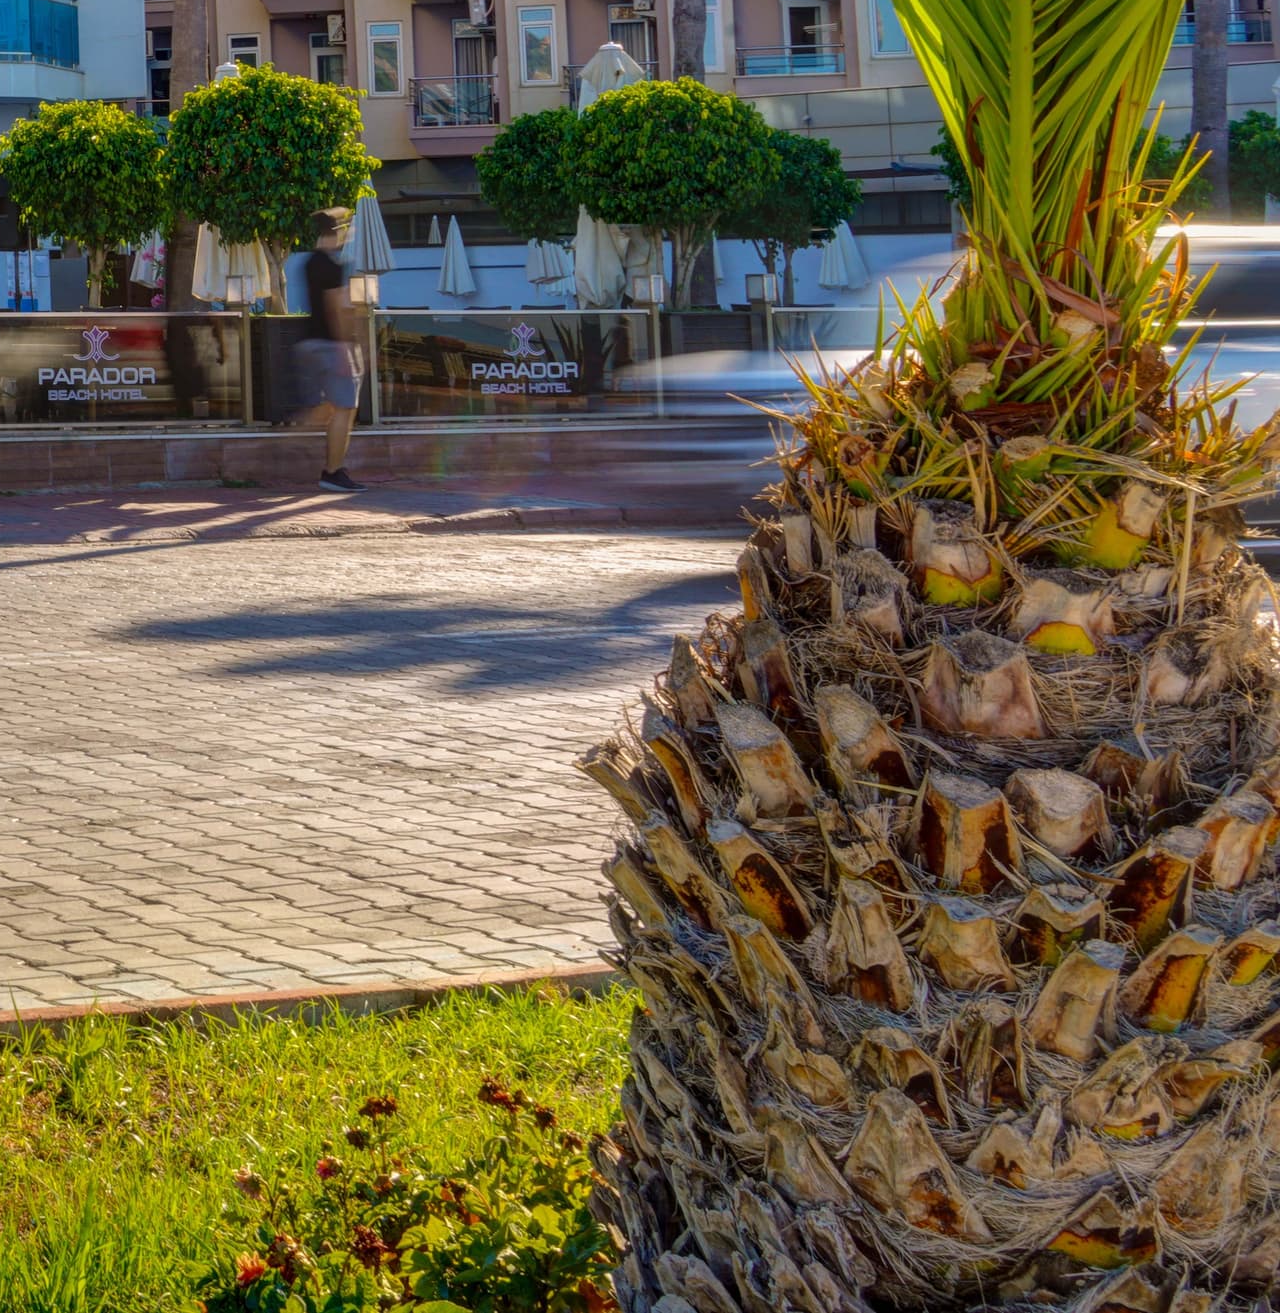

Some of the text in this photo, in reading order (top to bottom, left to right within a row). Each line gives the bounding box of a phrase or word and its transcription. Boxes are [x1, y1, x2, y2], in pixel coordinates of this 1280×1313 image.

[38, 367, 156, 385] PARADOR
[471, 361, 579, 379] PARADOR
[48, 388, 147, 401] BEACH HOTEL
[481, 382, 572, 394] BEACH HOTEL
